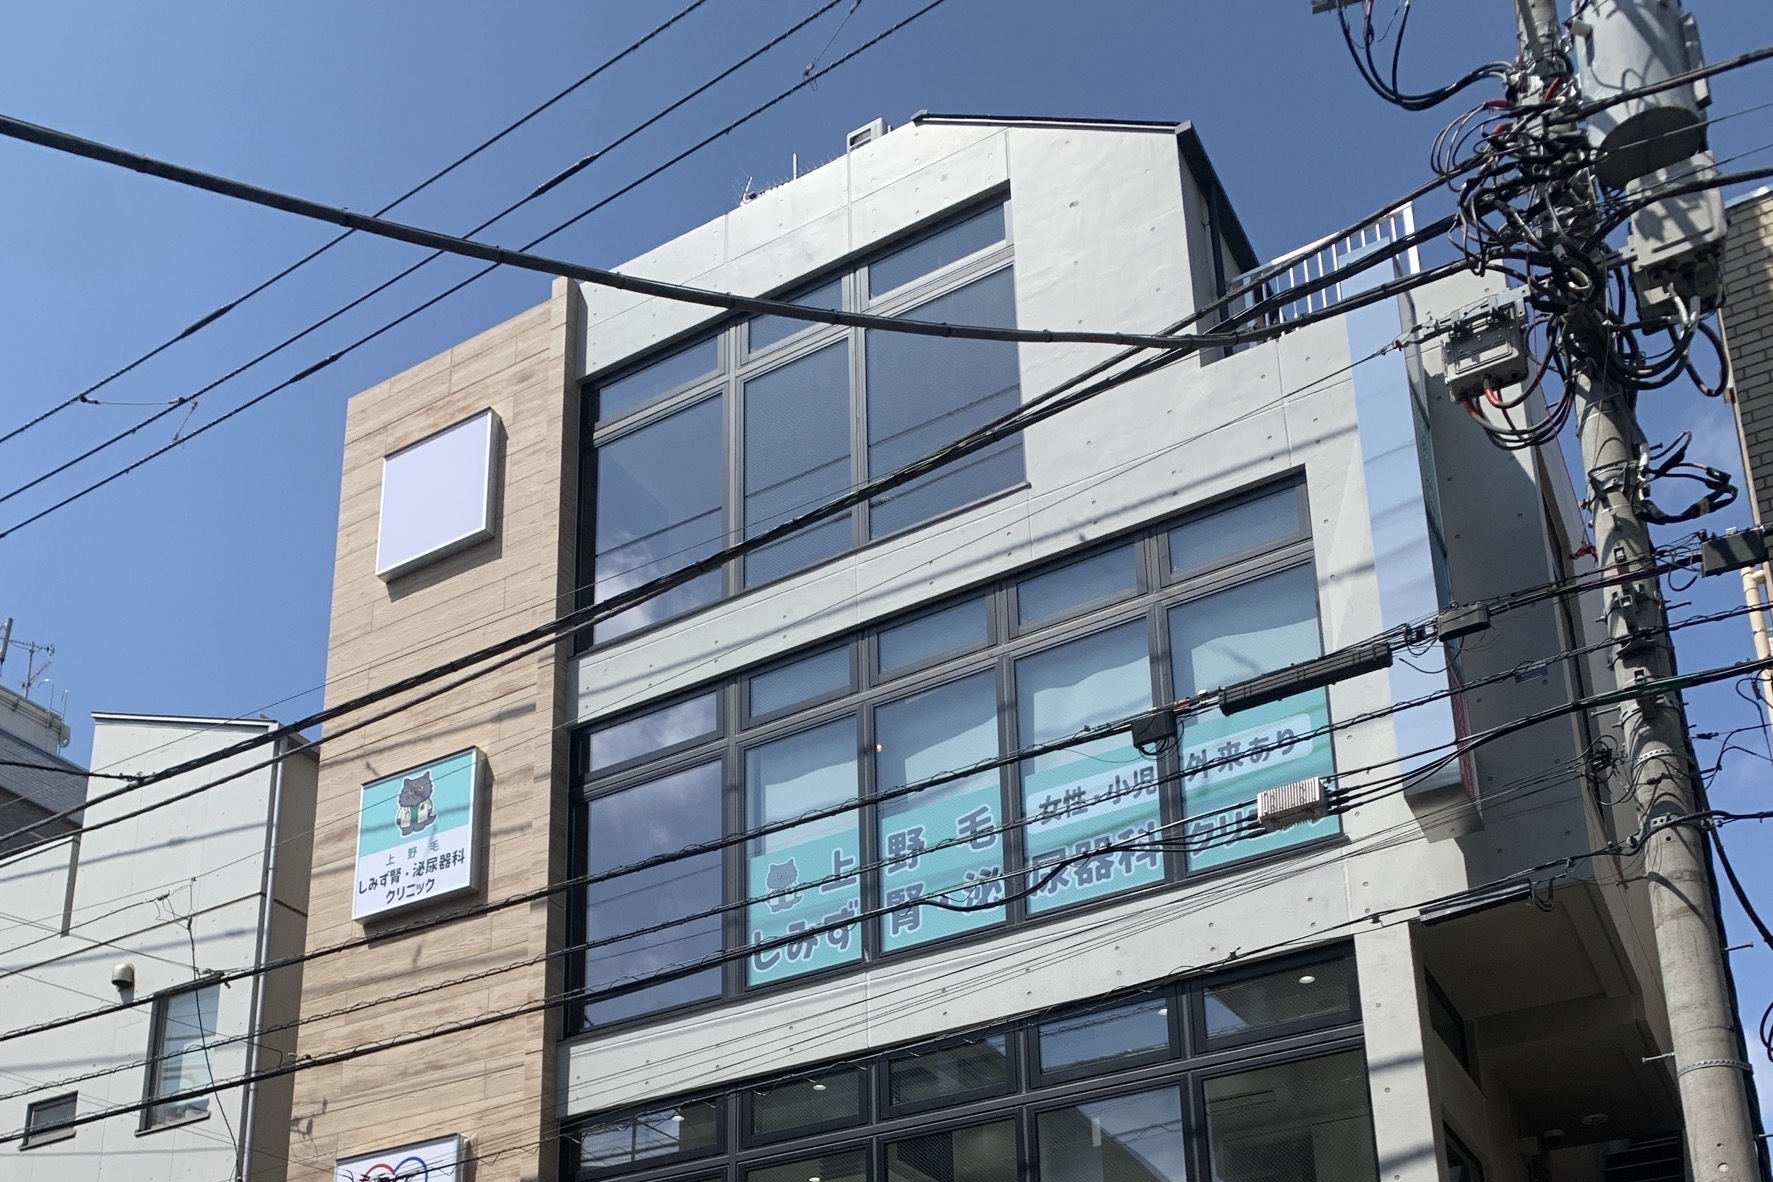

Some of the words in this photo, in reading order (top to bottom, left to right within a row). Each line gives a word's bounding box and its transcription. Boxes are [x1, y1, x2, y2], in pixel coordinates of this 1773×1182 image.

[385, 840, 440, 867] 上野毛
[358, 848, 465, 894] しみず腎・泌尿器科
[386, 877, 436, 905] クリニック
